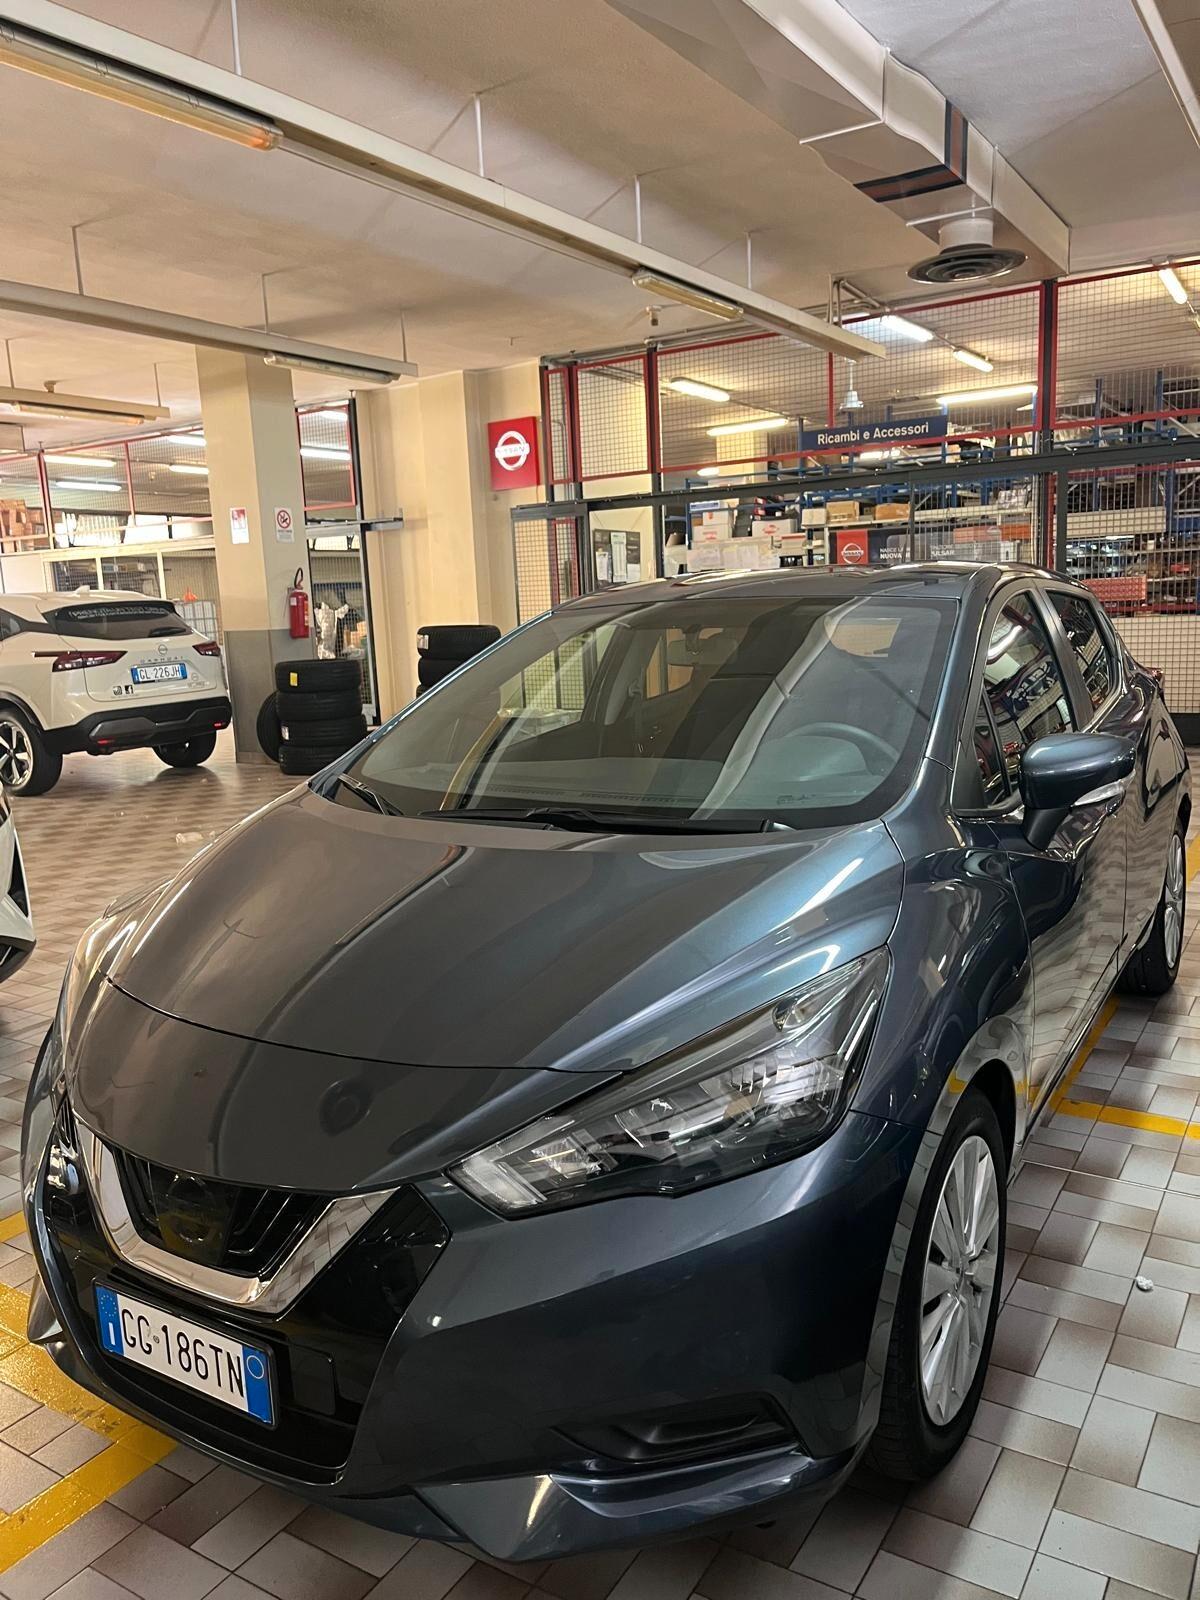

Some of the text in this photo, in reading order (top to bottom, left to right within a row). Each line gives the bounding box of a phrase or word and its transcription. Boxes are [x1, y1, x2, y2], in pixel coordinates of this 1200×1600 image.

[817, 421, 929, 445] Ricambi e Accessori
[879, 552, 902, 560] NUOVA
